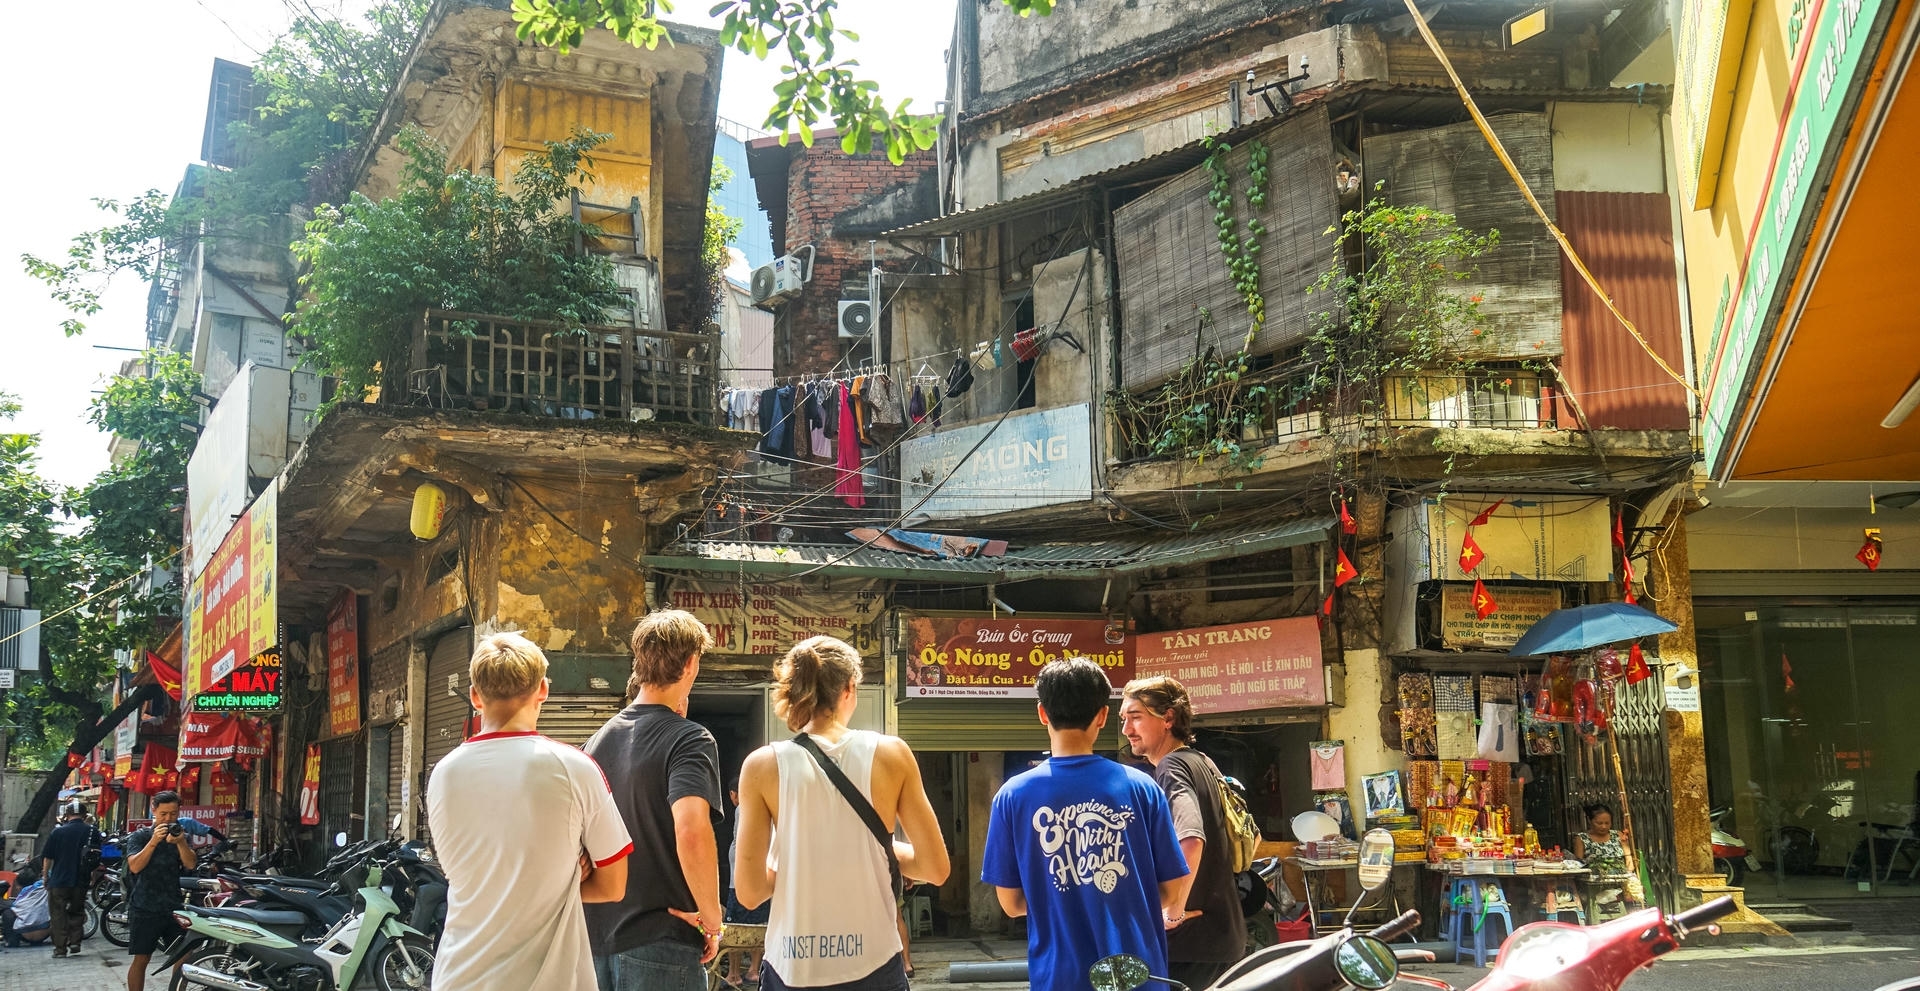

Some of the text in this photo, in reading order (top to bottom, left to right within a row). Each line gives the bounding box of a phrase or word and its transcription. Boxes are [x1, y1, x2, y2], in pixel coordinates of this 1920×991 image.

[673, 592, 706, 612] THỊT
[753, 599, 869, 613] QUE 7K
[820, 615, 847, 628] XIÊN
[976, 624, 1073, 647] Bún Ốc Trang
[1162, 626, 1273, 650] TÂN TRANG
[920, 643, 949, 666] Ốc
[954, 648, 1011, 671] Nóng
[232, 668, 279, 692] MÁY
[946, 675, 966, 686] Đặt
[993, 676, 1014, 685] Cua
[1022, 674, 1038, 685] Lẩ
[1178, 667, 1198, 683] DẠM
[1275, 658, 1291, 672] XIN
[198, 693, 280, 708] CHUYÊN NGHIỆP
[187, 723, 210, 733] MÁY
[205, 745, 235, 756] KHUNG
[196, 809, 216, 819] BAO
[1033, 799, 1131, 853] Experiences
[1065, 825, 1116, 857] With
[1049, 831, 1126, 886] Heart
[819, 933, 863, 959] BEACH
